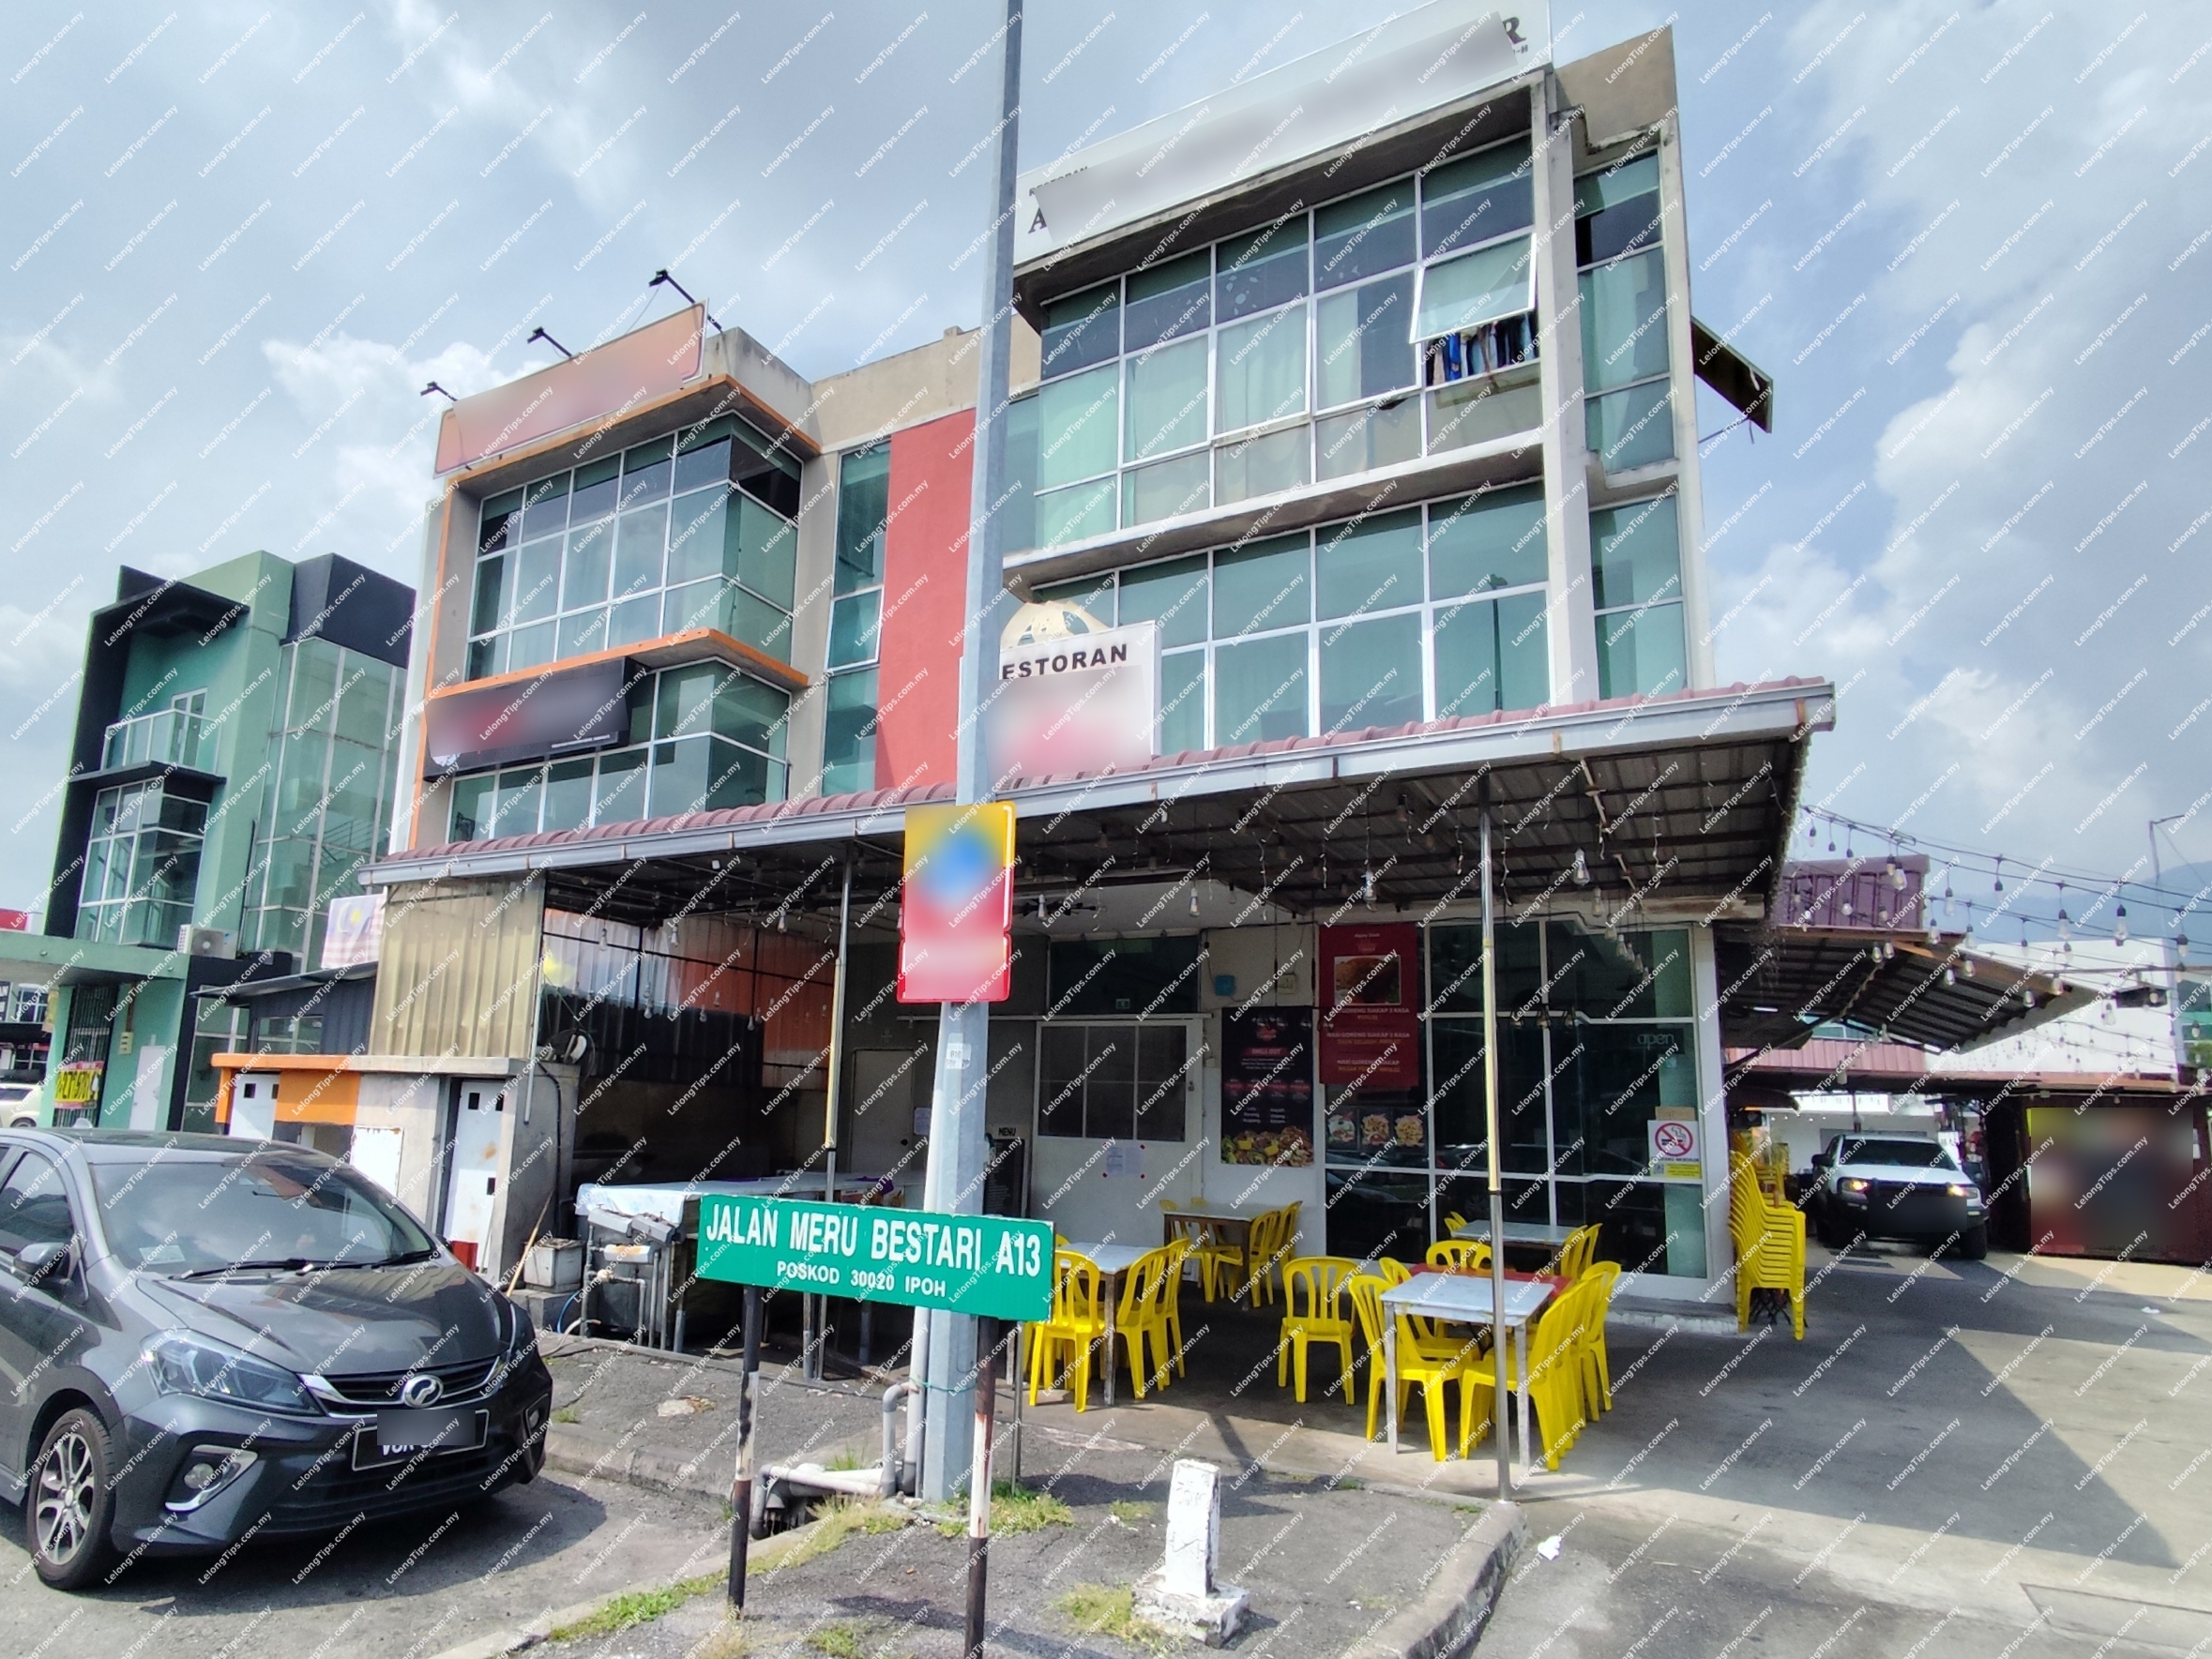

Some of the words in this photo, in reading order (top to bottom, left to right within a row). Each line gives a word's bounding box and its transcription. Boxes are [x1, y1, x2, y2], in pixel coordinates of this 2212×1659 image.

[1003, 643, 1128, 679] ESTORAN
[706, 1204, 779, 1247] JALAN
[789, 1211, 858, 1257] MERU
[871, 1218, 982, 1271] BESTARI
[995, 1230, 1041, 1276] A13
[777, 1260, 840, 1284] POSKOD
[850, 1269, 895, 1291] 30020
[905, 1275, 947, 1297] IPOH
